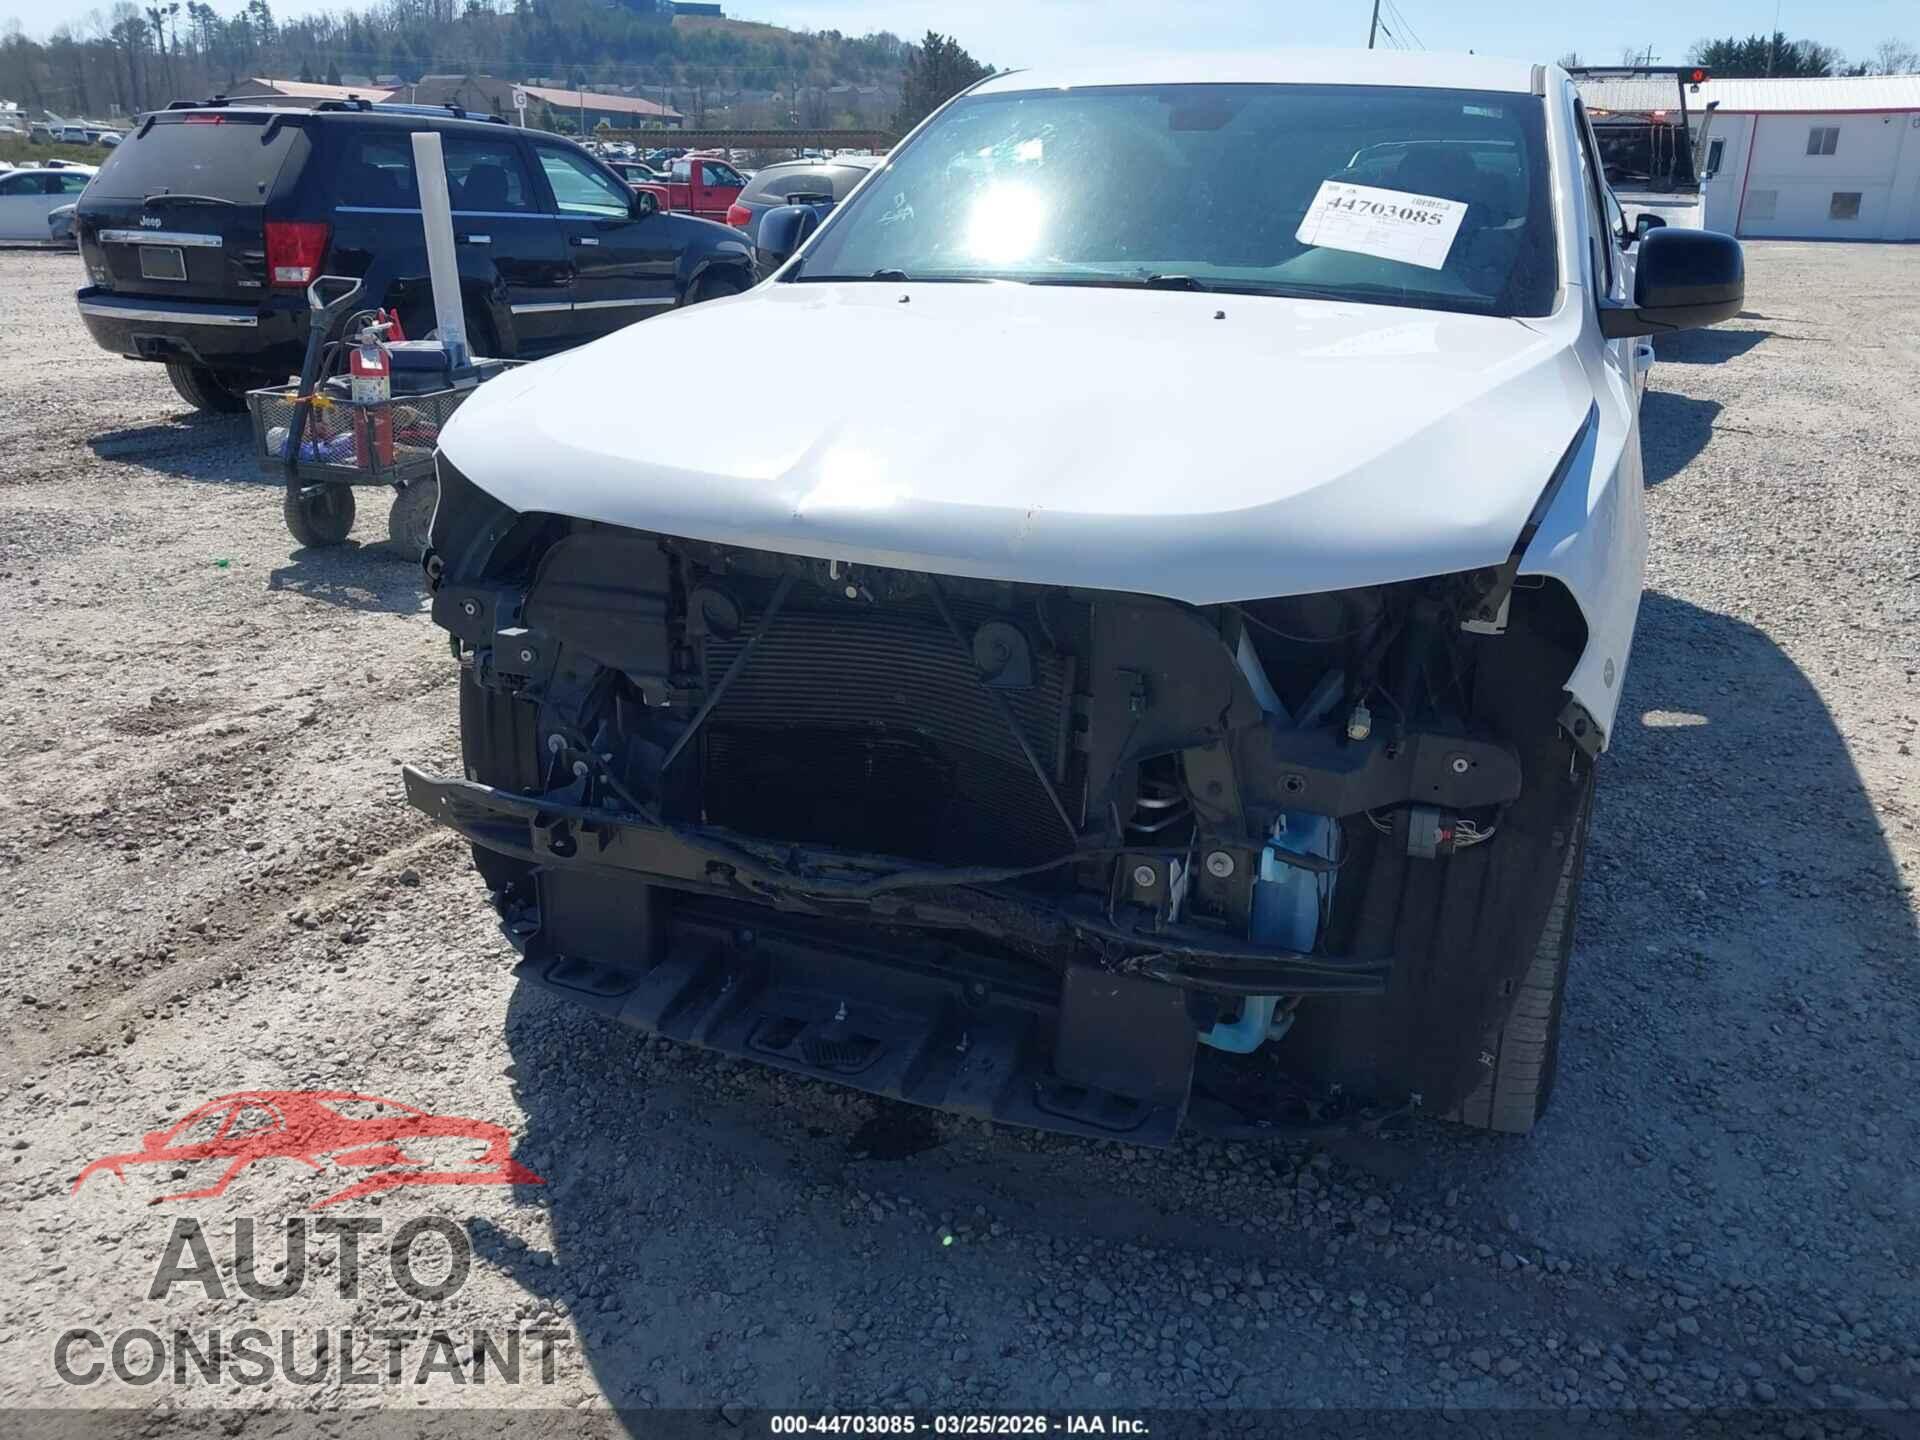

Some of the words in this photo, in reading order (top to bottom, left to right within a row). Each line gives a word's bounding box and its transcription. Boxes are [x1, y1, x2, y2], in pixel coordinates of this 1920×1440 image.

[515, 93, 526, 105] G
[1327, 197, 1444, 225] 44703085
[139, 215, 162, 229] Jeep
